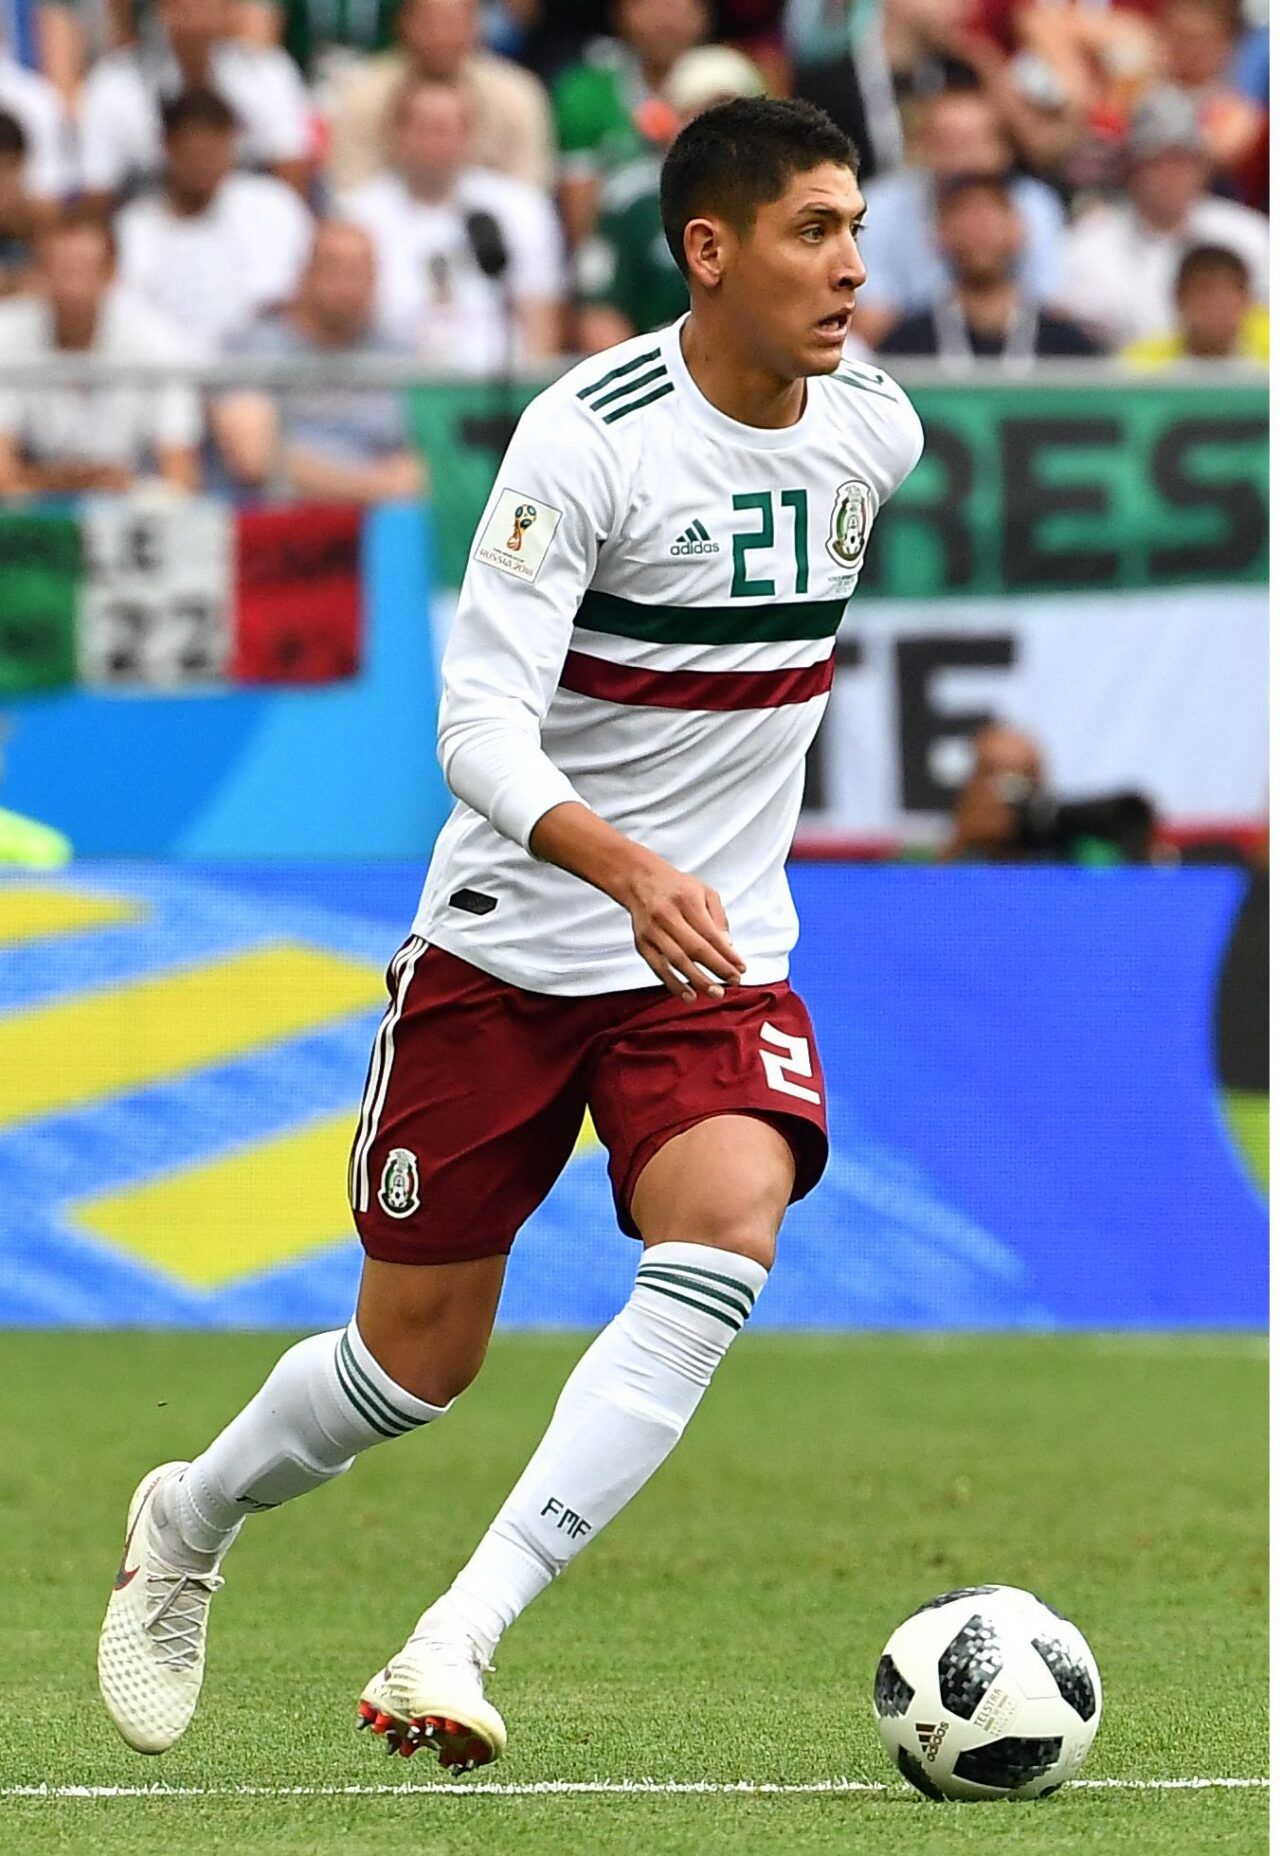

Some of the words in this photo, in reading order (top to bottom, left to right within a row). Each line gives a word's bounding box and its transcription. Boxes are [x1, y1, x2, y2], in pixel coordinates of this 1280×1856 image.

[480, 548, 513, 568] RUSSIA
[670, 541, 720, 556] adidas
[730, 488, 809, 598] 21
[759, 1020, 821, 1106] 2
[540, 1496, 592, 1539] FMF
[926, 1721, 949, 1762] adidas
